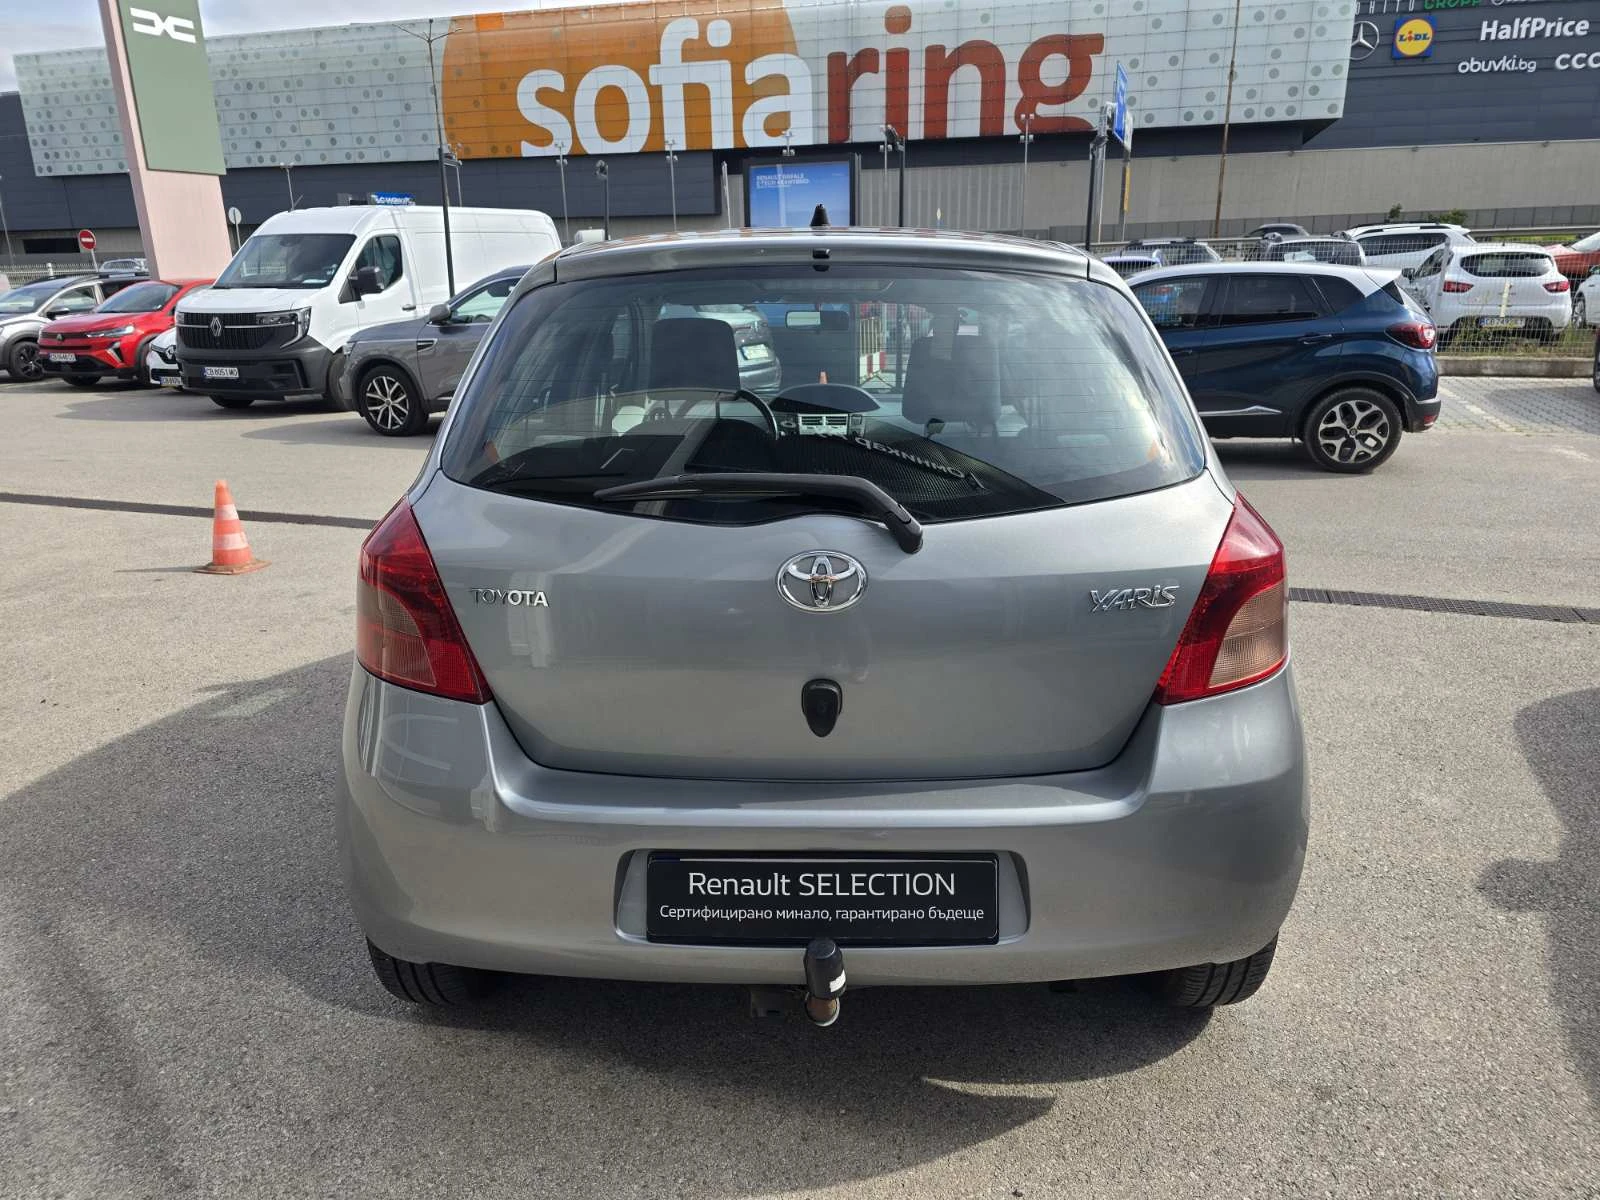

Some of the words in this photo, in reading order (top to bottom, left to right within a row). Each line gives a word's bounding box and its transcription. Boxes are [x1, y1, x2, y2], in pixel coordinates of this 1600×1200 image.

[1480, 16, 1590, 41] HalfPrice
[1458, 55, 1537, 73] obuvki.bg
[469, 587, 549, 607] TOYOTA
[689, 873, 790, 895] Renault
[800, 873, 954, 895] SELECTION
[660, 905, 772, 921] Сертифицирано
[776, 908, 832, 921] минало,
[835, 908, 925, 922] гарантирано
[929, 906, 984, 920] бъдеще
